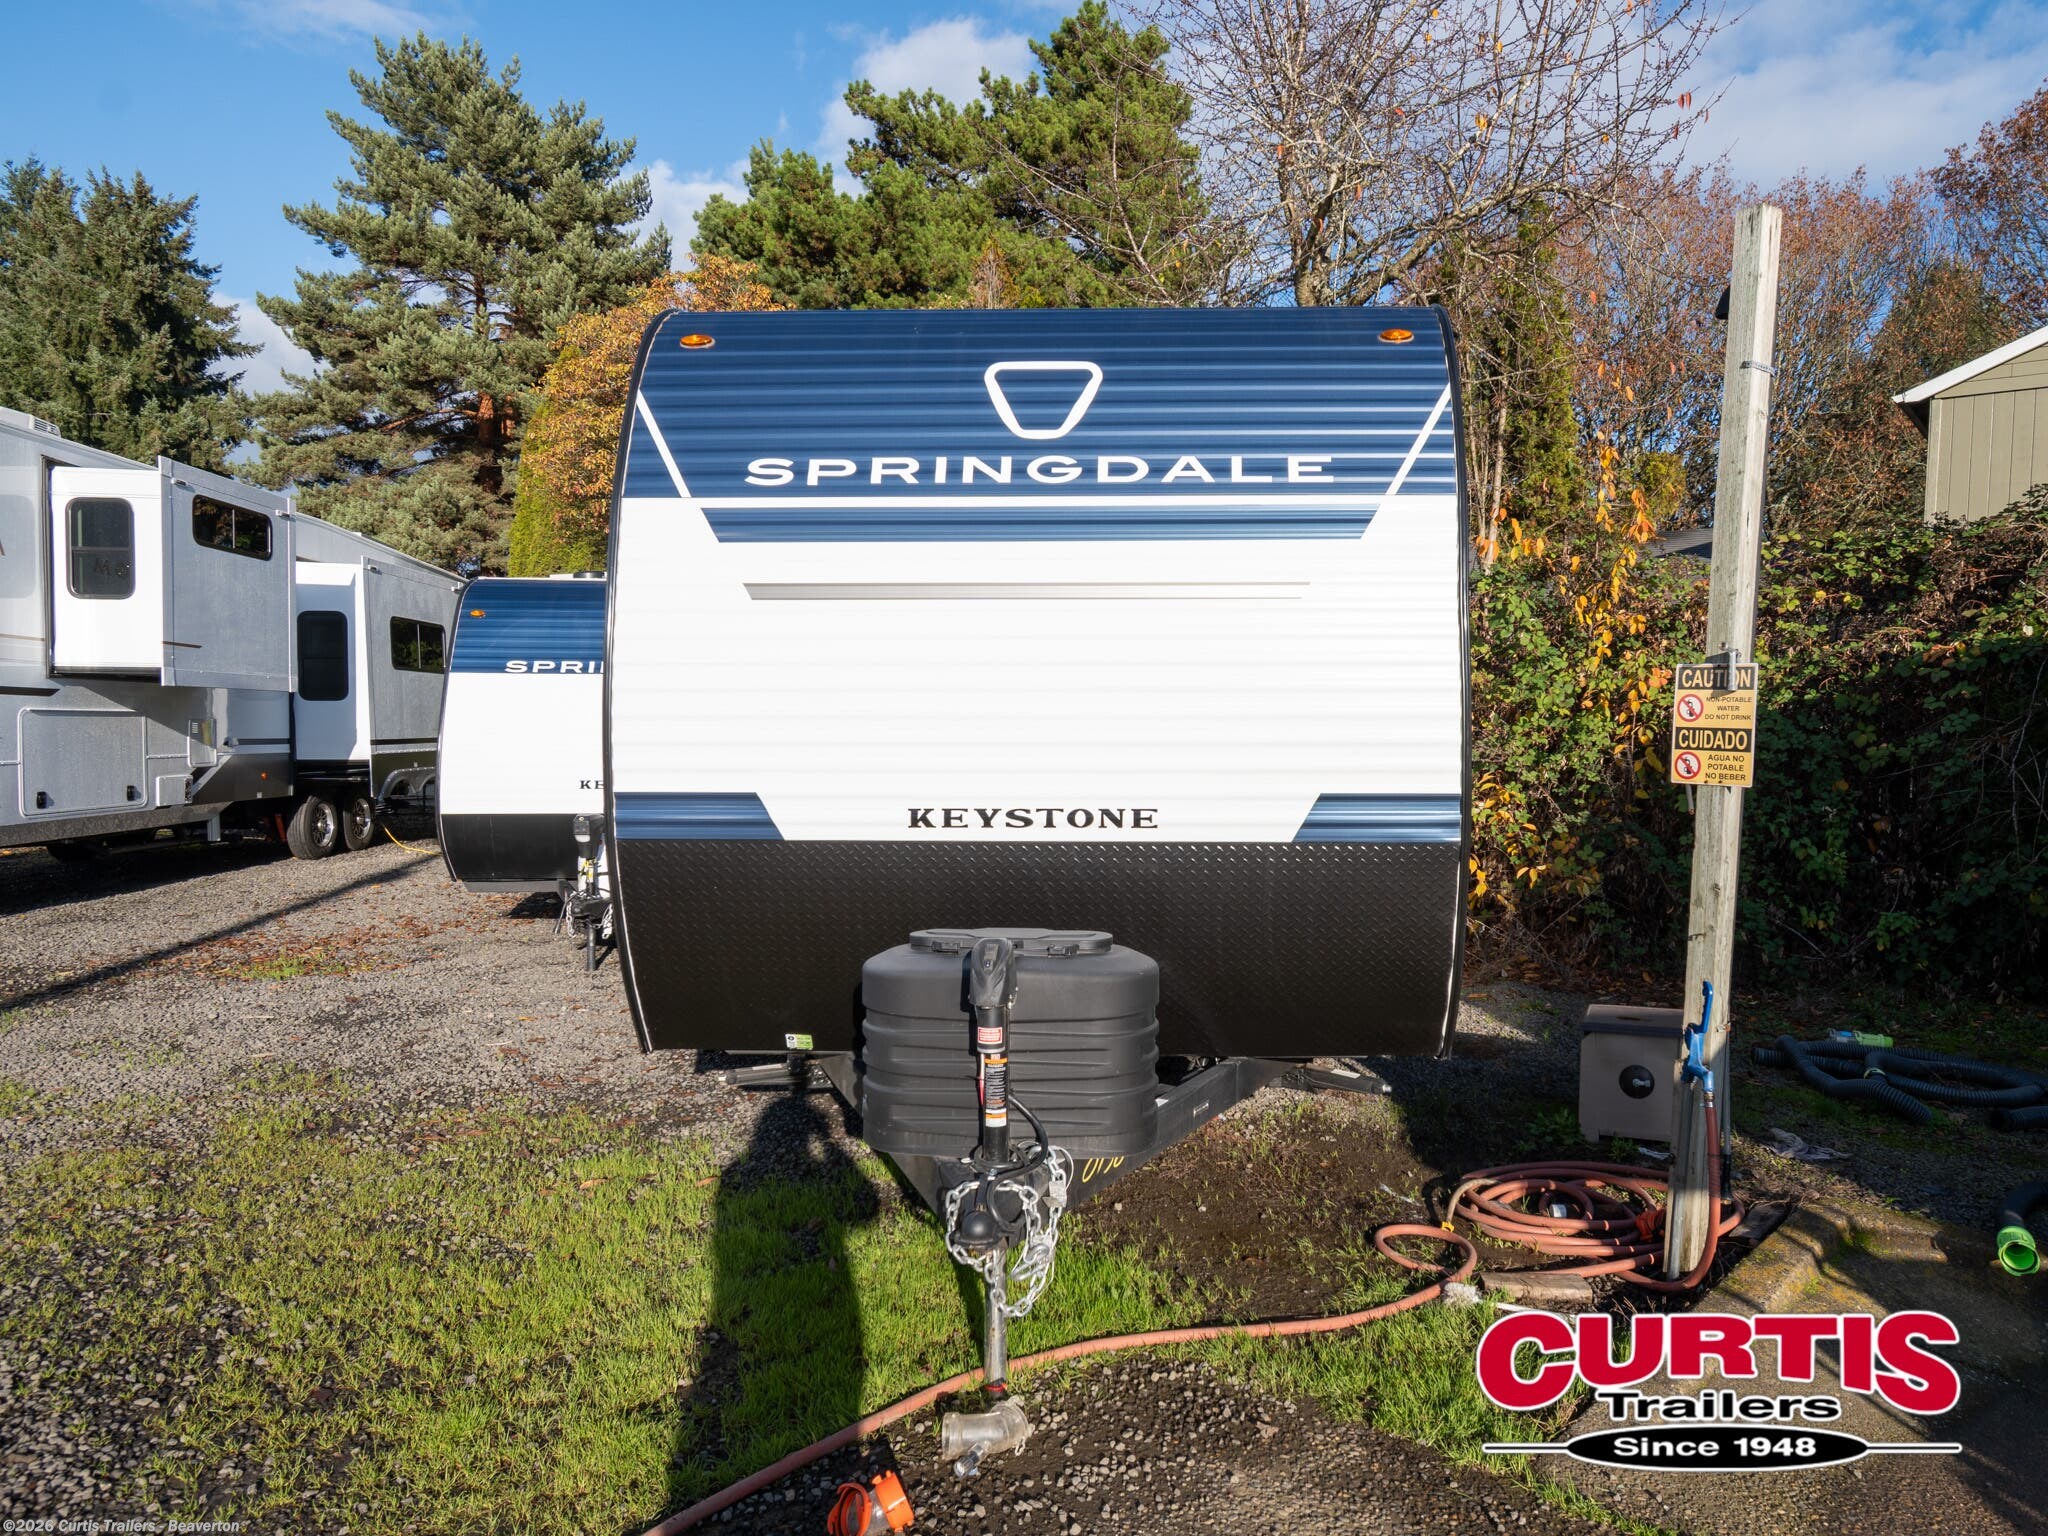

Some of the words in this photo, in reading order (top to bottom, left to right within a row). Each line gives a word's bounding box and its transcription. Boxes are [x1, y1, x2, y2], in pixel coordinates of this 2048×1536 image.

[744, 456, 1334, 486] SPRINGDALE
[505, 660, 604, 673] SPRI
[1679, 730, 1748, 750] CUIDADO
[1732, 755, 1745, 763] NO
[1707, 763, 1744, 772] POTABLE
[907, 808, 1159, 829] KEYSTONE
